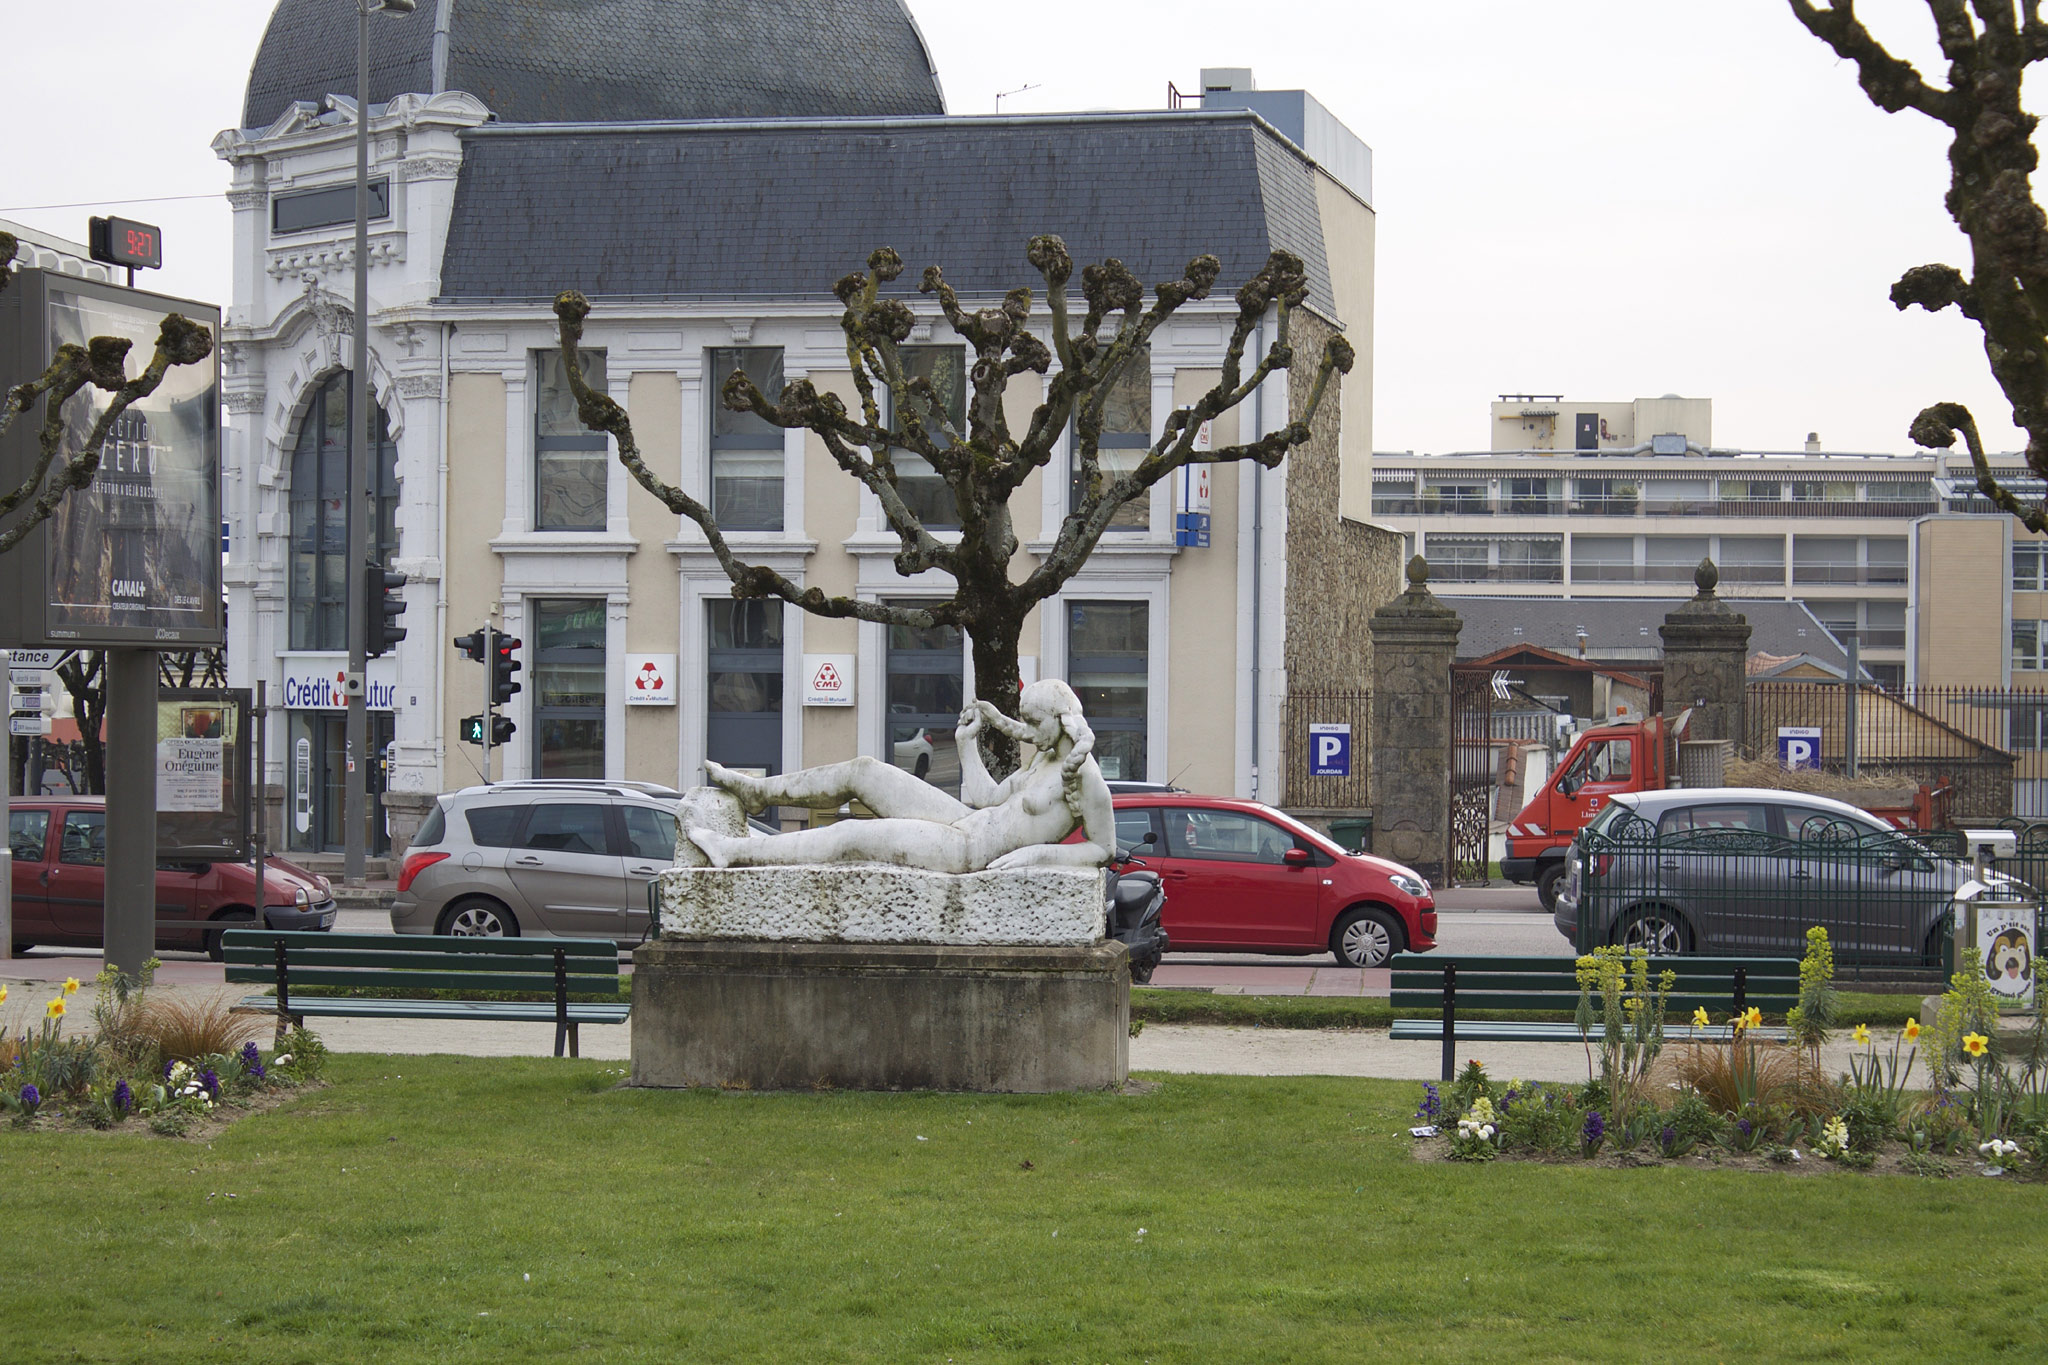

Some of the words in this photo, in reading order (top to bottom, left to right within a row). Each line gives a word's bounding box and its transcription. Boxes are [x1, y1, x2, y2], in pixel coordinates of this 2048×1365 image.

[127, 230, 152, 257] 9:27
[108, 418, 157, 441] ECTION
[92, 481, 99, 493] LE
[101, 482, 119, 495] FUTUR
[112, 579, 146, 598] CANAL+
[155, 628, 179, 640] JCDecaux
[9, 650, 49, 662] tance
[286, 676, 330, 706] Crédit
[178, 748, 219, 763] Eugène
[1318, 736, 1342, 766] P
[1787, 740, 1812, 770] P
[164, 760, 219, 775] Onéguine
[1986, 927, 2000, 937] Un
